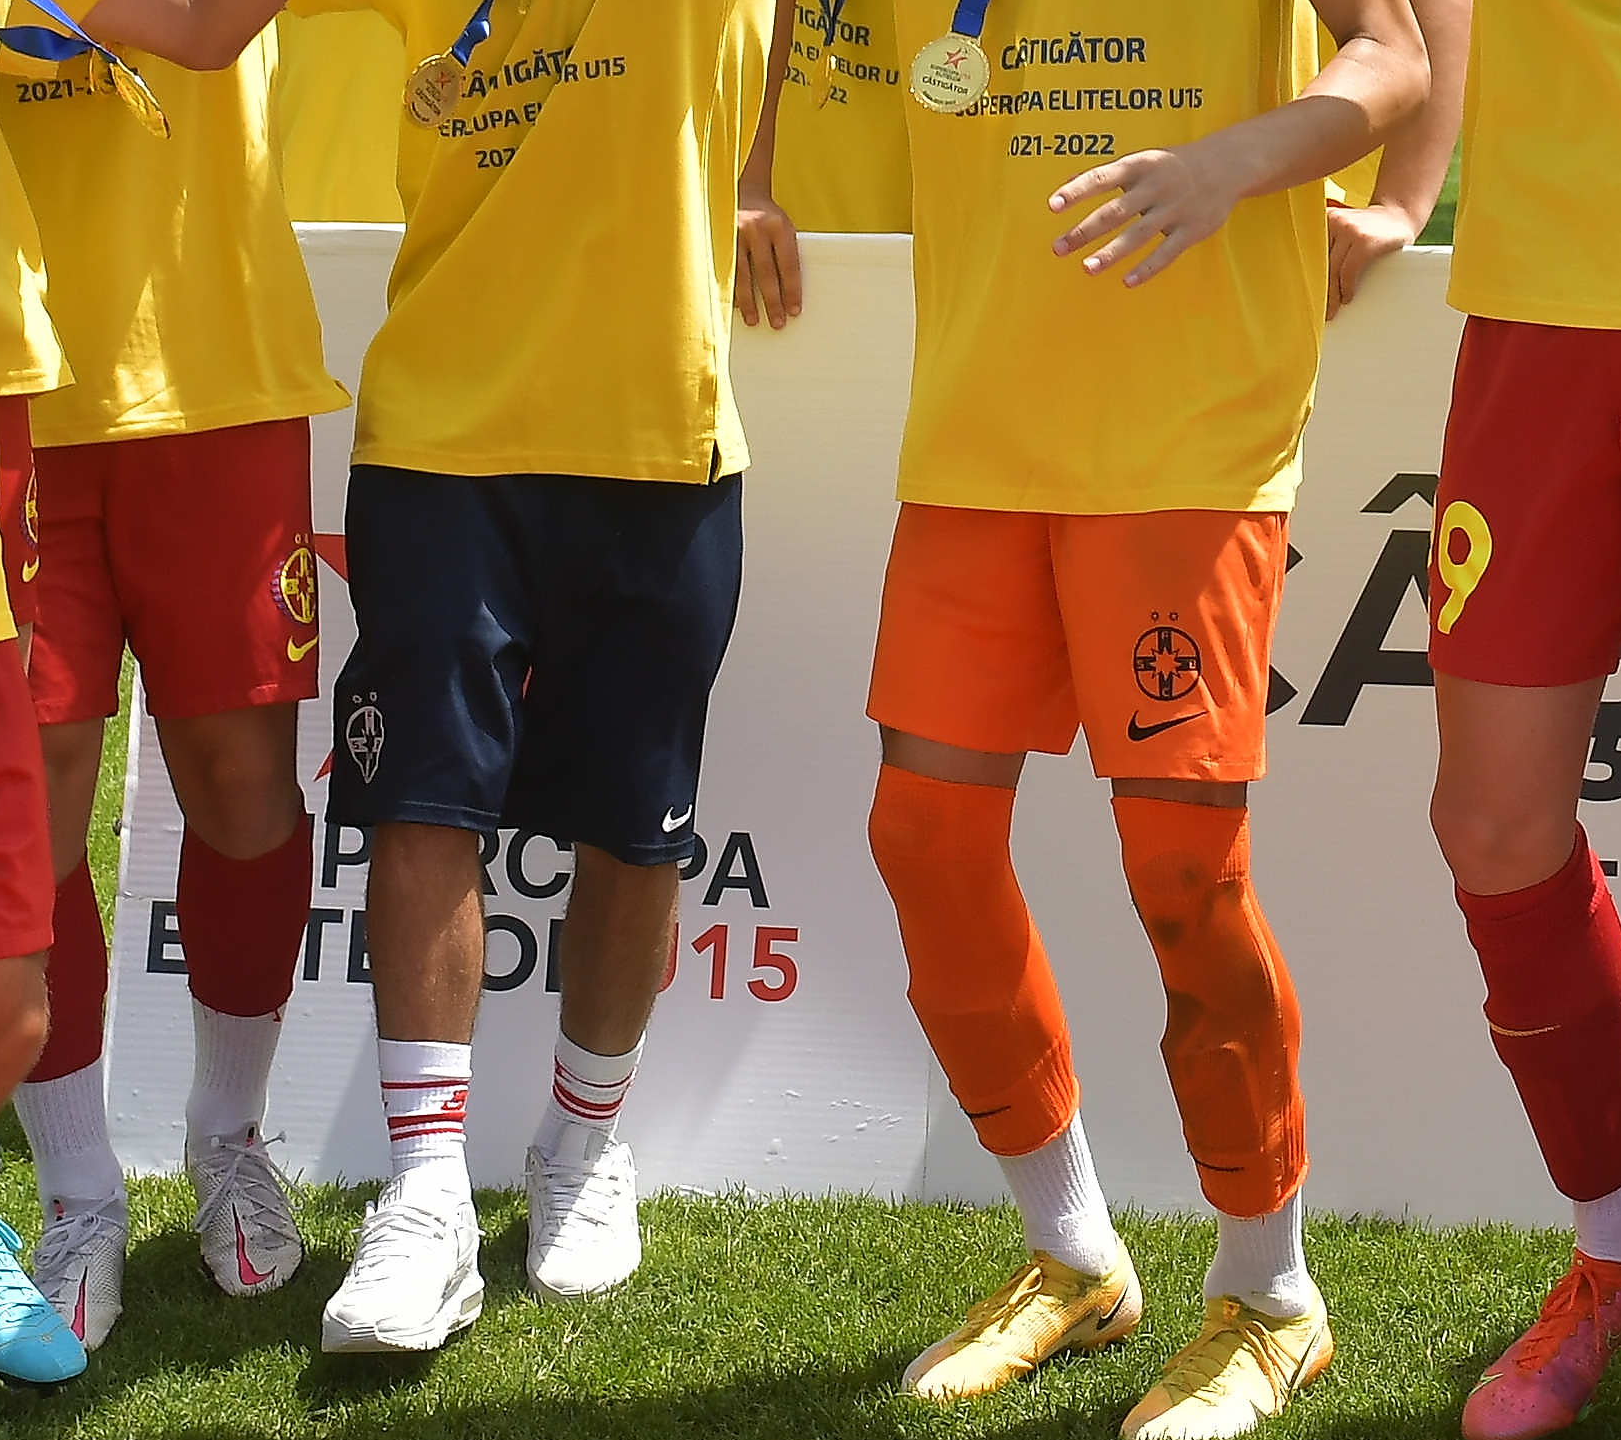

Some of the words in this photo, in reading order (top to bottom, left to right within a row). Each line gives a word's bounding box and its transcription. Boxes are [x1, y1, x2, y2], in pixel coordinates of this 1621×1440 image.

[584, 57, 626, 80] U15
[1048, 87, 1164, 111] ELITELOR
[1168, 87, 1204, 110] U15
[1431, 500, 1493, 635] 9
